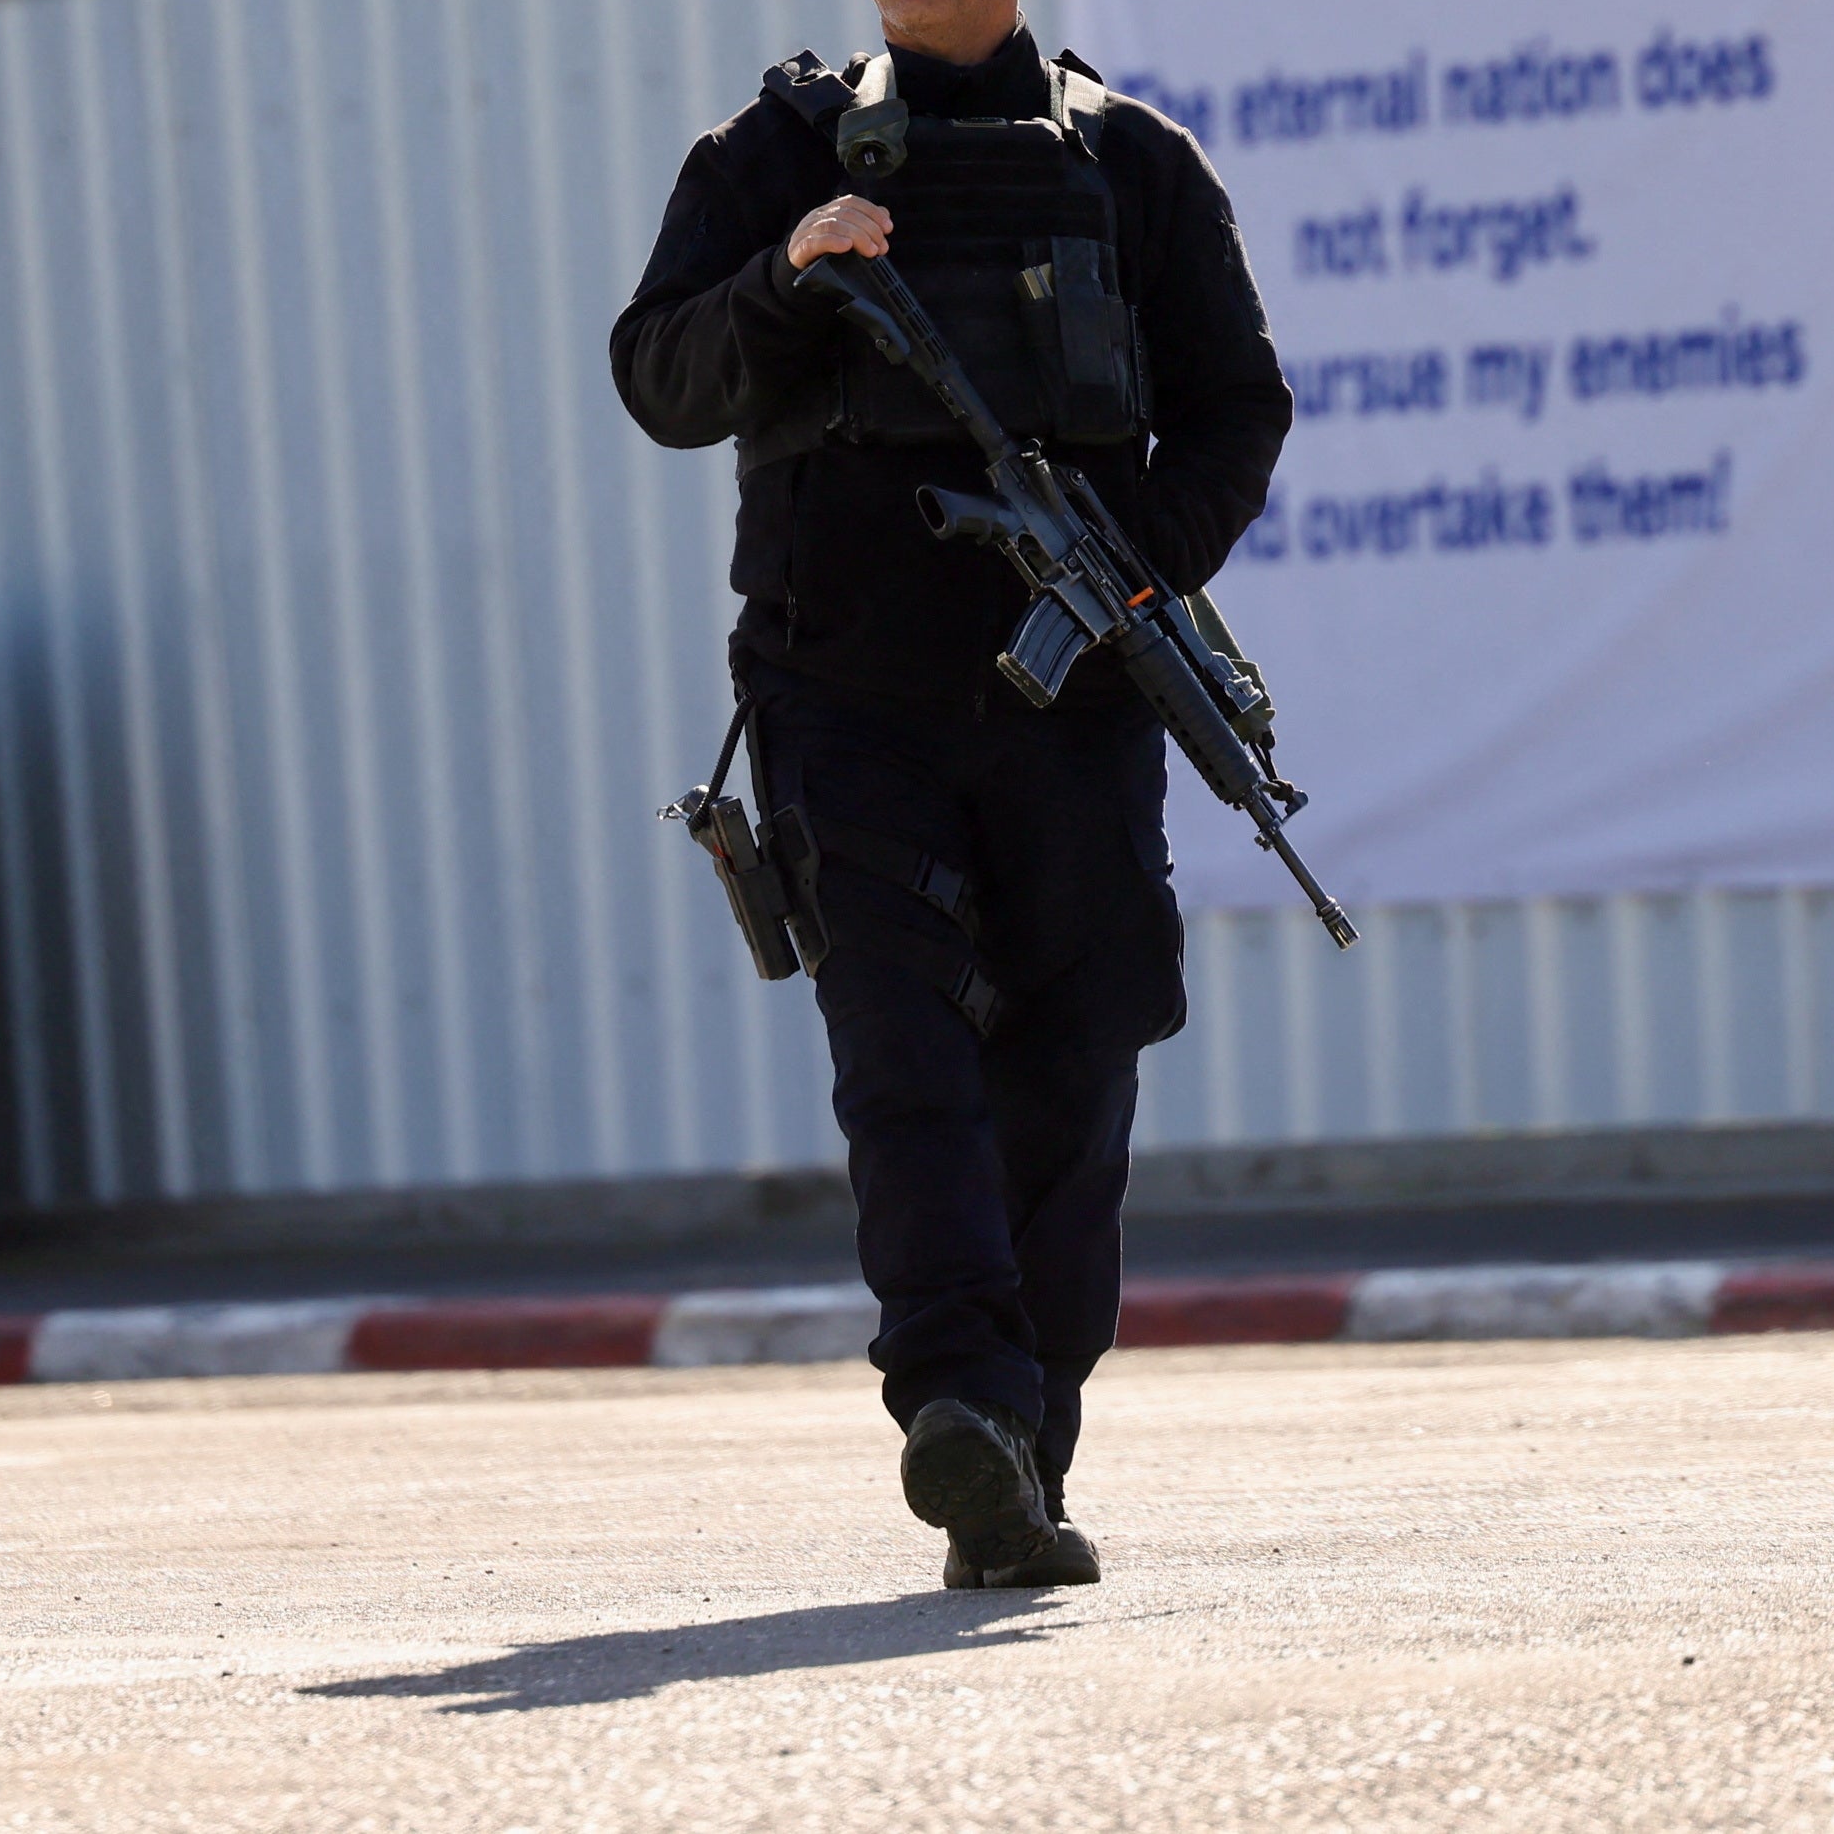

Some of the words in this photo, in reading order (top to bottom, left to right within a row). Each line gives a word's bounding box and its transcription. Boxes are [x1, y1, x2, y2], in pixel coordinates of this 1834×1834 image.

[1231, 50, 1426, 145] eternal
[1444, 38, 1619, 124] nation
[1635, 27, 1776, 110] does
[1297, 202, 1386, 277] not
[1280, 349, 1448, 421] ursue
[1466, 344, 1549, 425] my
[1565, 309, 1807, 401] enemies
[1300, 466, 1553, 562] overtake
